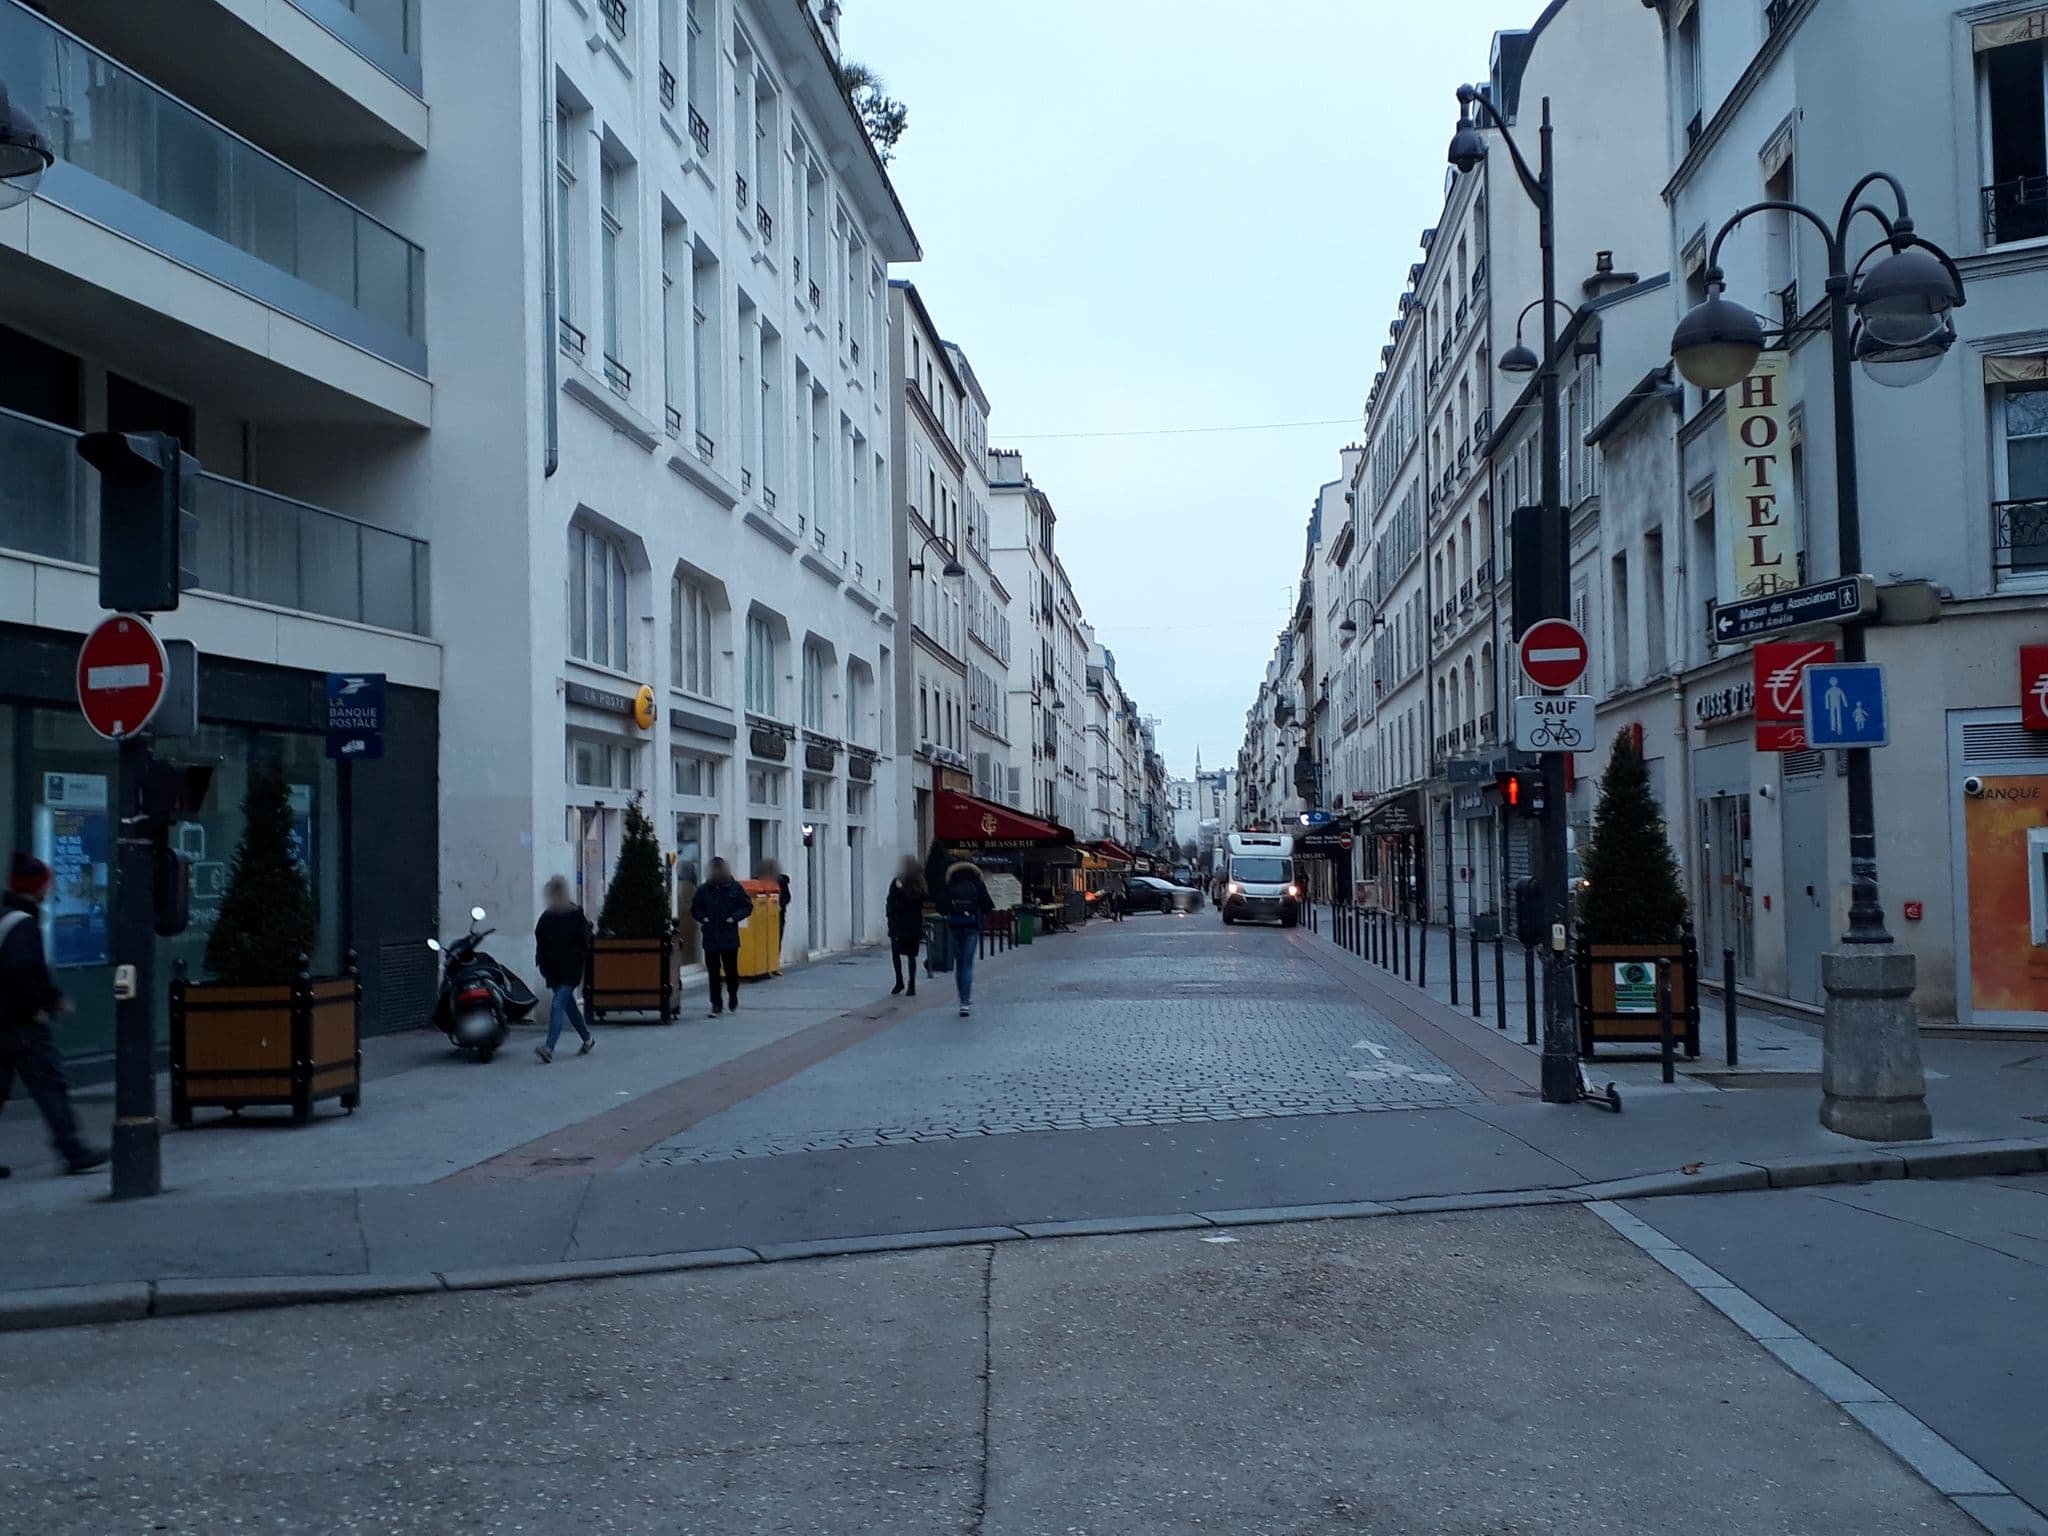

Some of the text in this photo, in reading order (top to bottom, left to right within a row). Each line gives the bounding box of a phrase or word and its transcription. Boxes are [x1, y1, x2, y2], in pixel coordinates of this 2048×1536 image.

[1738, 374, 1782, 567] HOTEL
[1740, 589, 1837, 620] Maison des Associations
[1749, 620, 1764, 631] Rue
[1767, 614, 1794, 627] Amélie
[329, 698, 344, 707] LA
[599, 693, 625, 710] POSTE
[1534, 701, 1577, 714] SAUF
[1696, 688, 1730, 721] CAISSE
[329, 707, 377, 717] BANQUE
[329, 718, 378, 728] POSTALE
[959, 840, 1034, 849] BAR BRASSERIE
